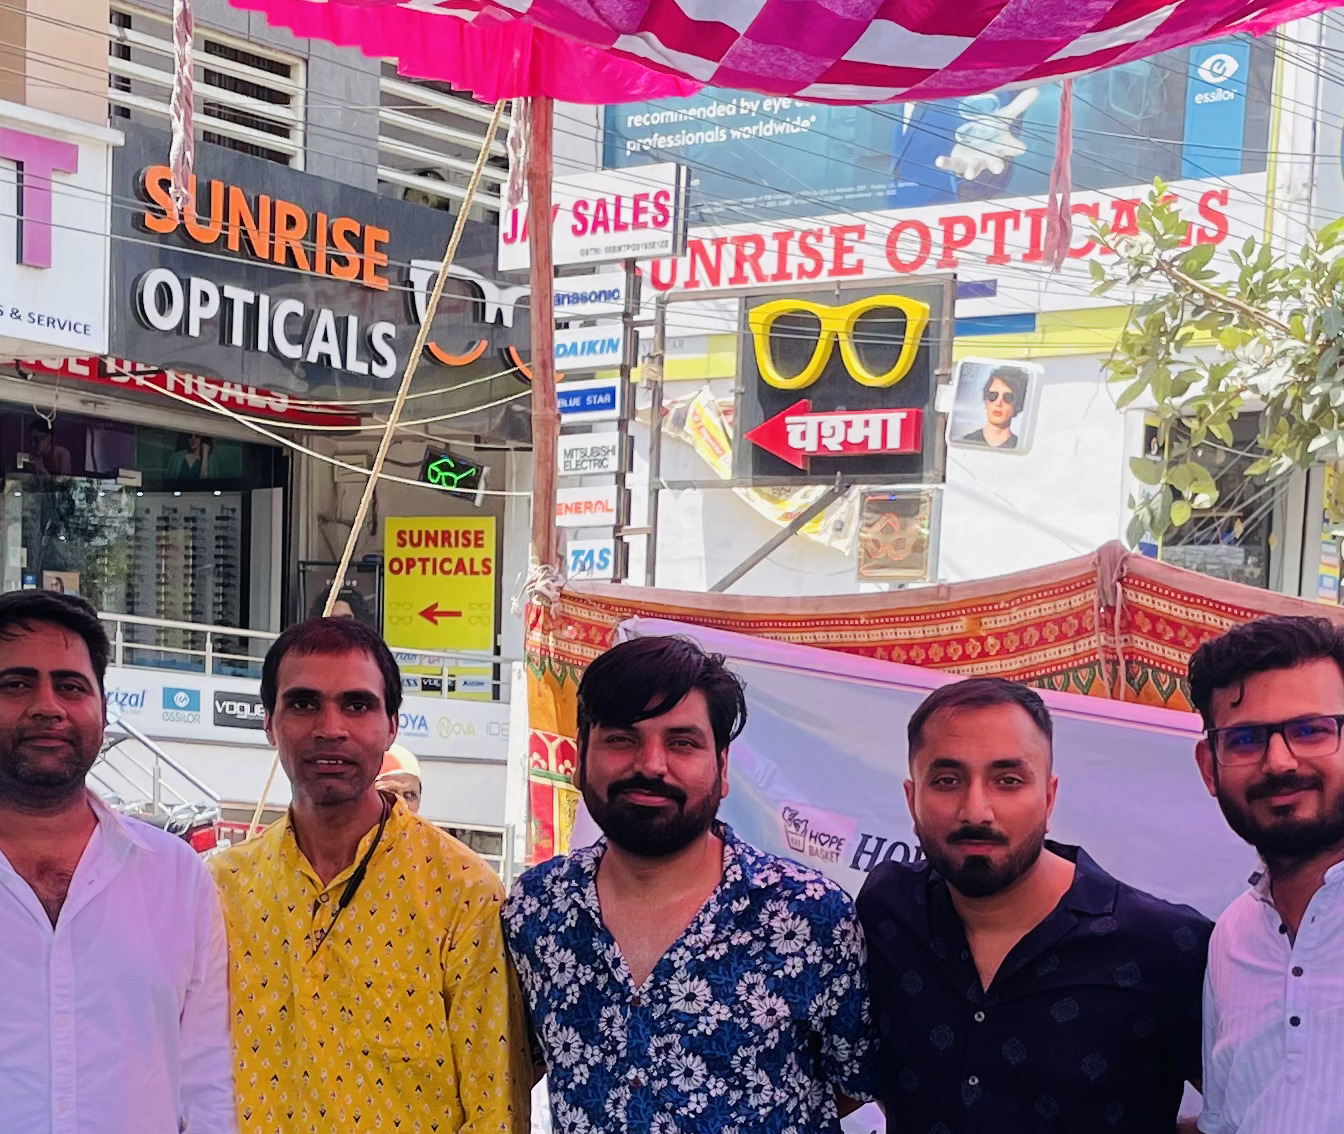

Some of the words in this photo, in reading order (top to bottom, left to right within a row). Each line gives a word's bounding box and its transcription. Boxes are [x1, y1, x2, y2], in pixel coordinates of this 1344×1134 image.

[1194, 88, 1237, 105] essilor
[627, 98, 737, 128] recommended
[739, 95, 760, 118] by
[762, 96, 791, 114] eye
[626, 127, 727, 156] professionals
[571, 190, 671, 238] SALES
[142, 164, 391, 291] SUNRISE
[621, 223, 867, 293] UNRISE
[554, 288, 621, 308] anasonic
[10, 306, 22, 321] &
[28, 312, 93, 335] SERVICE
[142, 267, 398, 379] OPTICALS
[555, 337, 621, 359] DAIKIN
[586, 394, 612, 407] STAR
[785, 412, 907, 452] चश्मा
[563, 446, 617, 459] MITSUBISHI
[563, 458, 609, 472] ELECTRIC
[555, 500, 615, 516] ENERAL
[396, 529, 485, 548] SUNRISE
[388, 557, 492, 576] OPTICALS
[106, 689, 146, 709] rizal
[399, 713, 429, 732] OYA
[808, 845, 841, 864] BASKET
